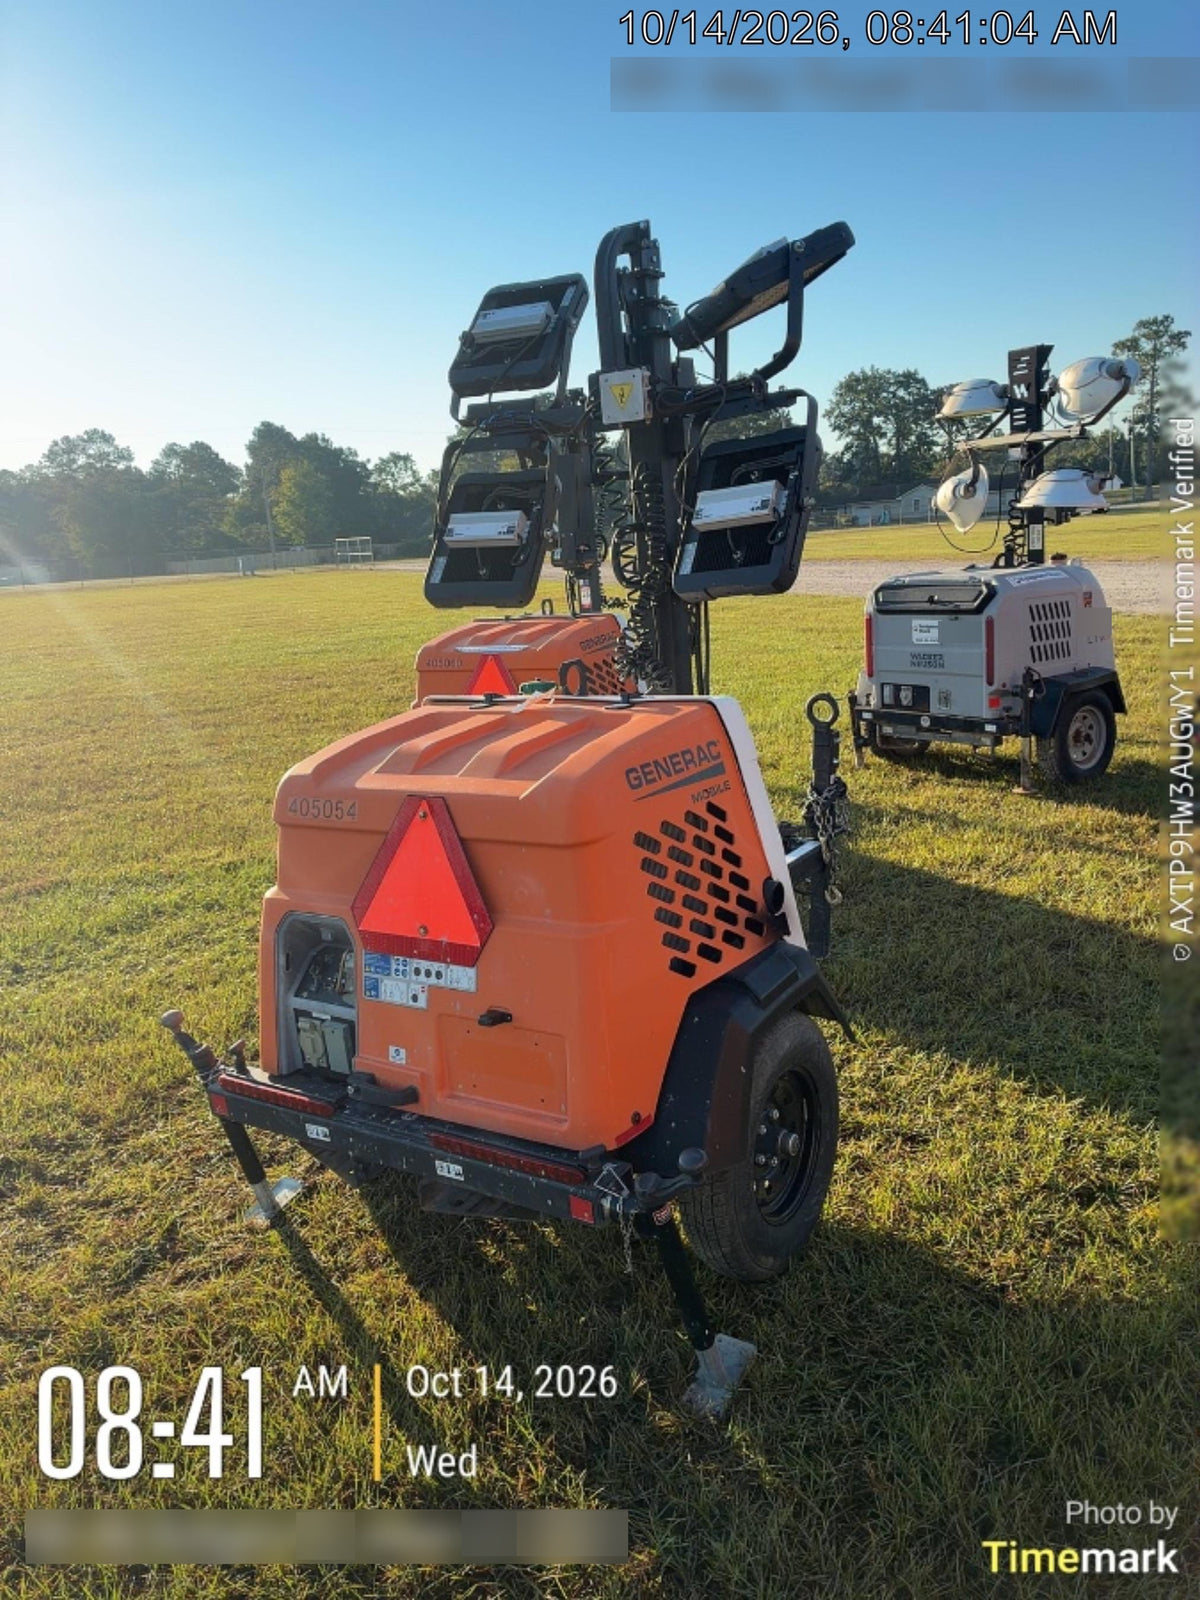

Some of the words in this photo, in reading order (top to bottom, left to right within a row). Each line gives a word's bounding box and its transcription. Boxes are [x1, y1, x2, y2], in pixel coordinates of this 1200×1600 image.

[625, 740, 721, 790] GENERAC
[691, 780, 731, 805] MOBILE
[288, 798, 358, 820] 405054
